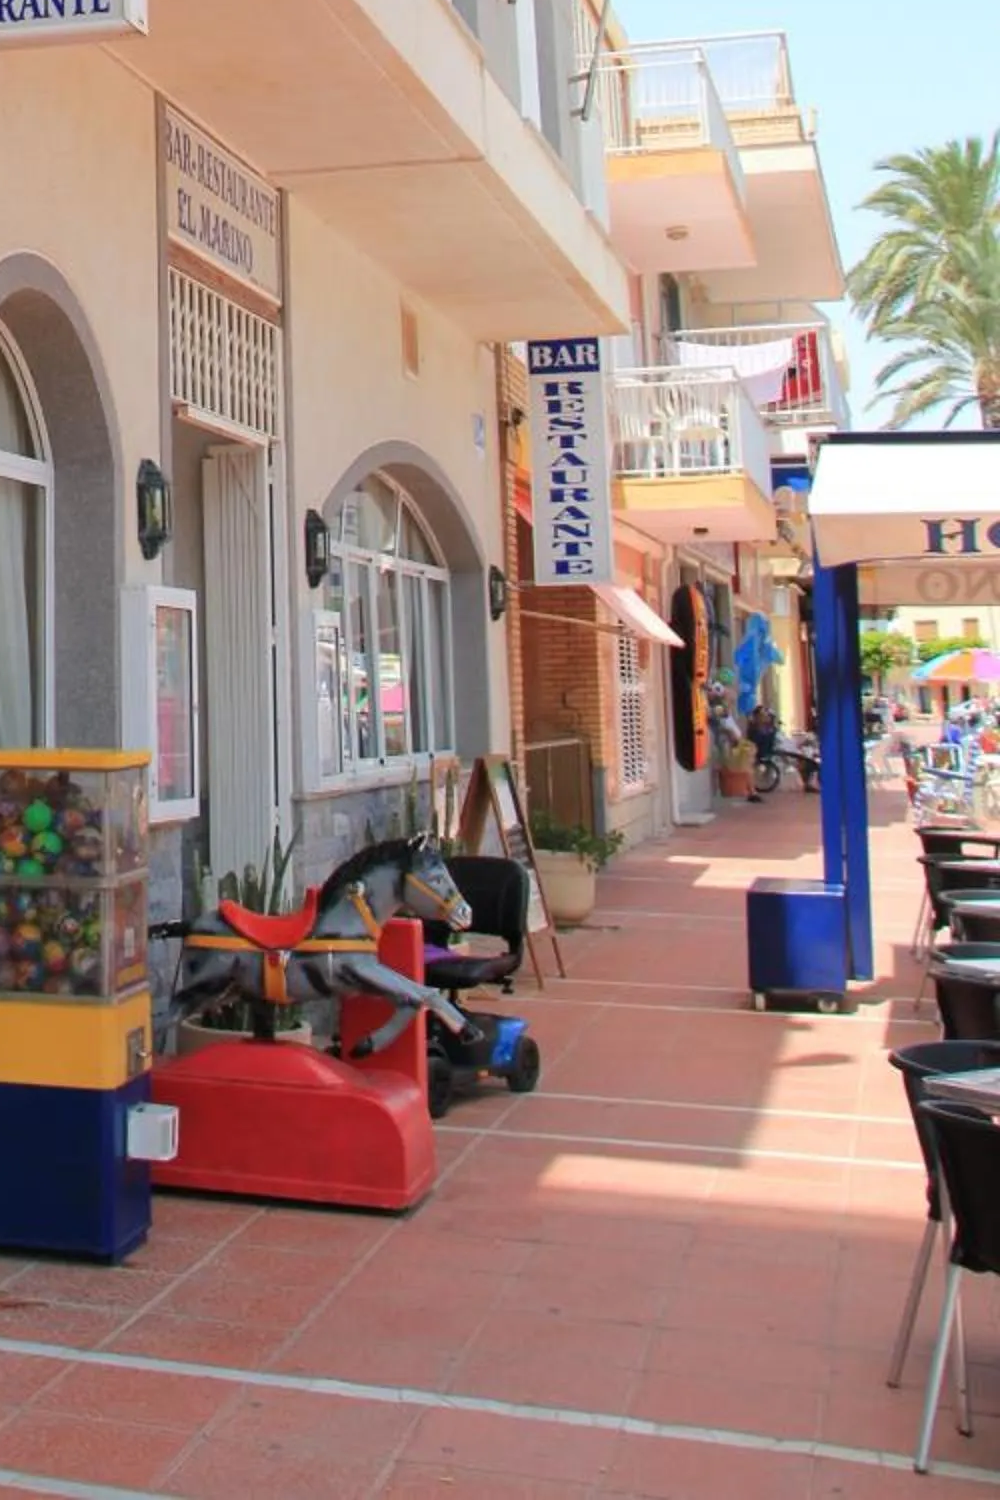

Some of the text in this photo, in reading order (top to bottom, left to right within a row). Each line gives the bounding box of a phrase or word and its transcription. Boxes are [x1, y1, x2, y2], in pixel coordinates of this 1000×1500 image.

[177, 187, 254, 274] EL MARINO
[531, 343, 598, 367] BAR
[544, 381, 594, 575] RESTAURANTE
